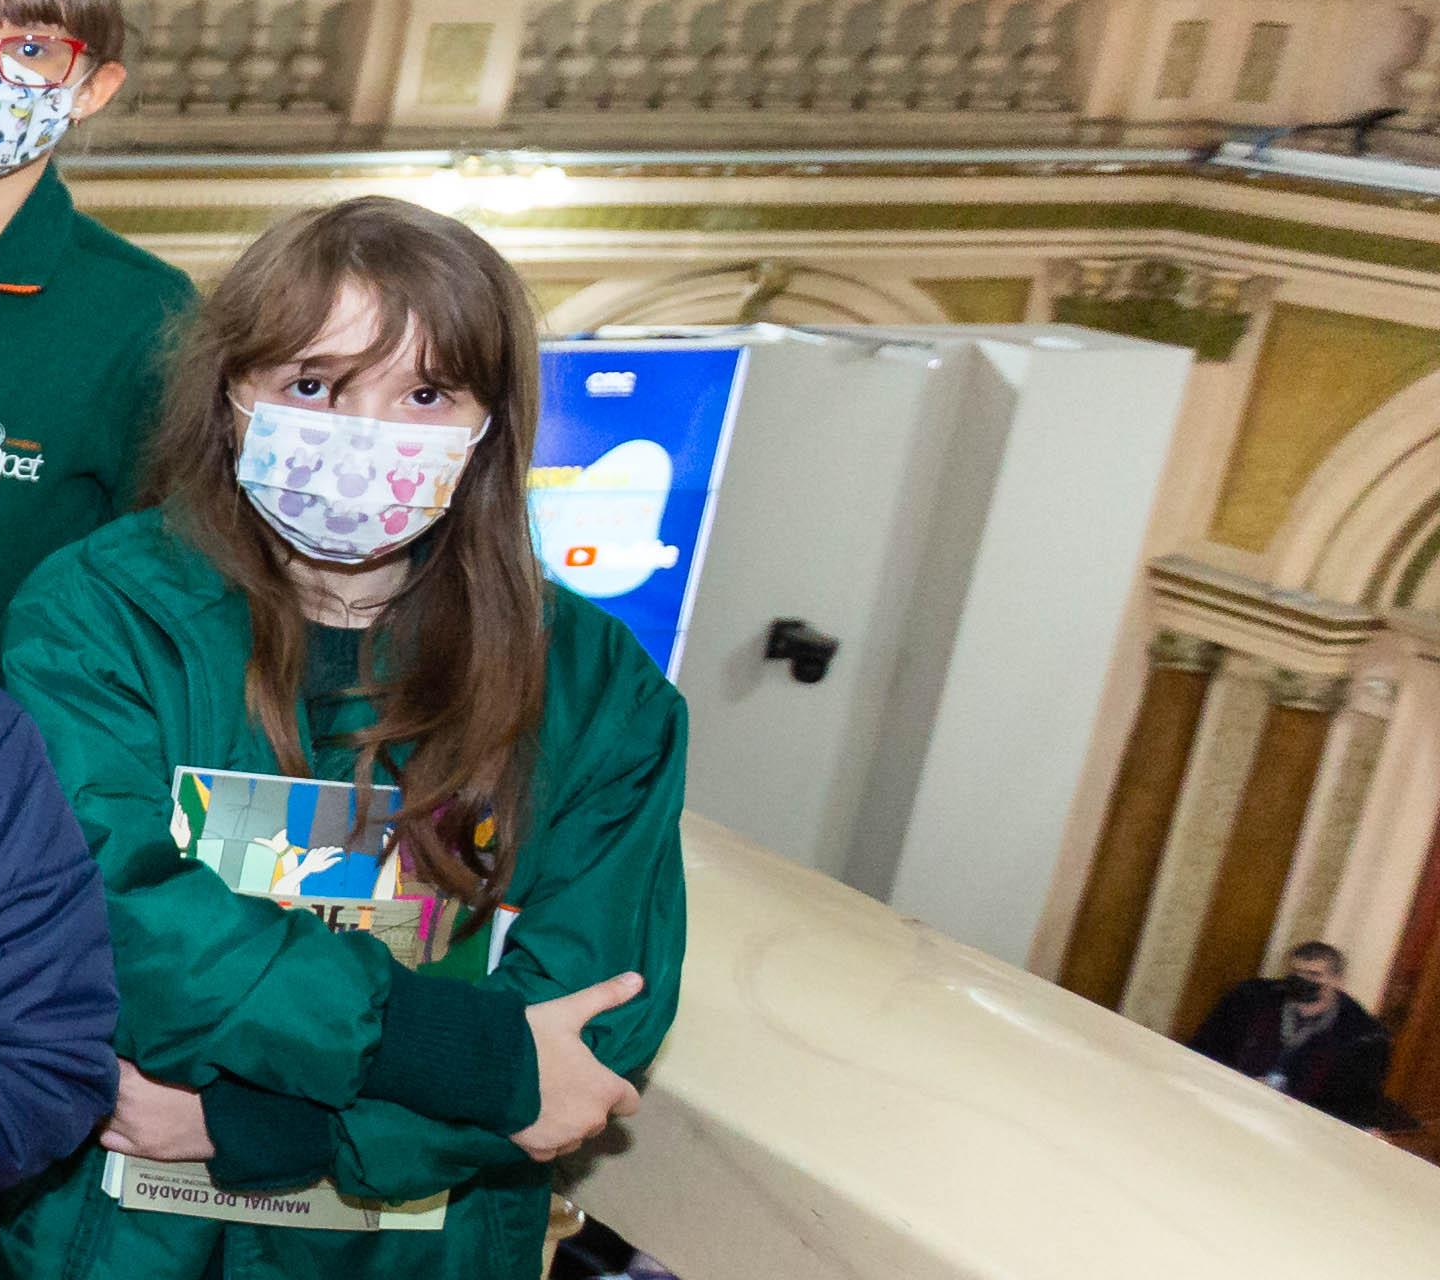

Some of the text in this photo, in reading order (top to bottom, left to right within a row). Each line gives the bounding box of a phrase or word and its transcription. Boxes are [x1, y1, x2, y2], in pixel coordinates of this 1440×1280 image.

[136, 1182, 311, 1214] MANUAL DO CIDADÃO
